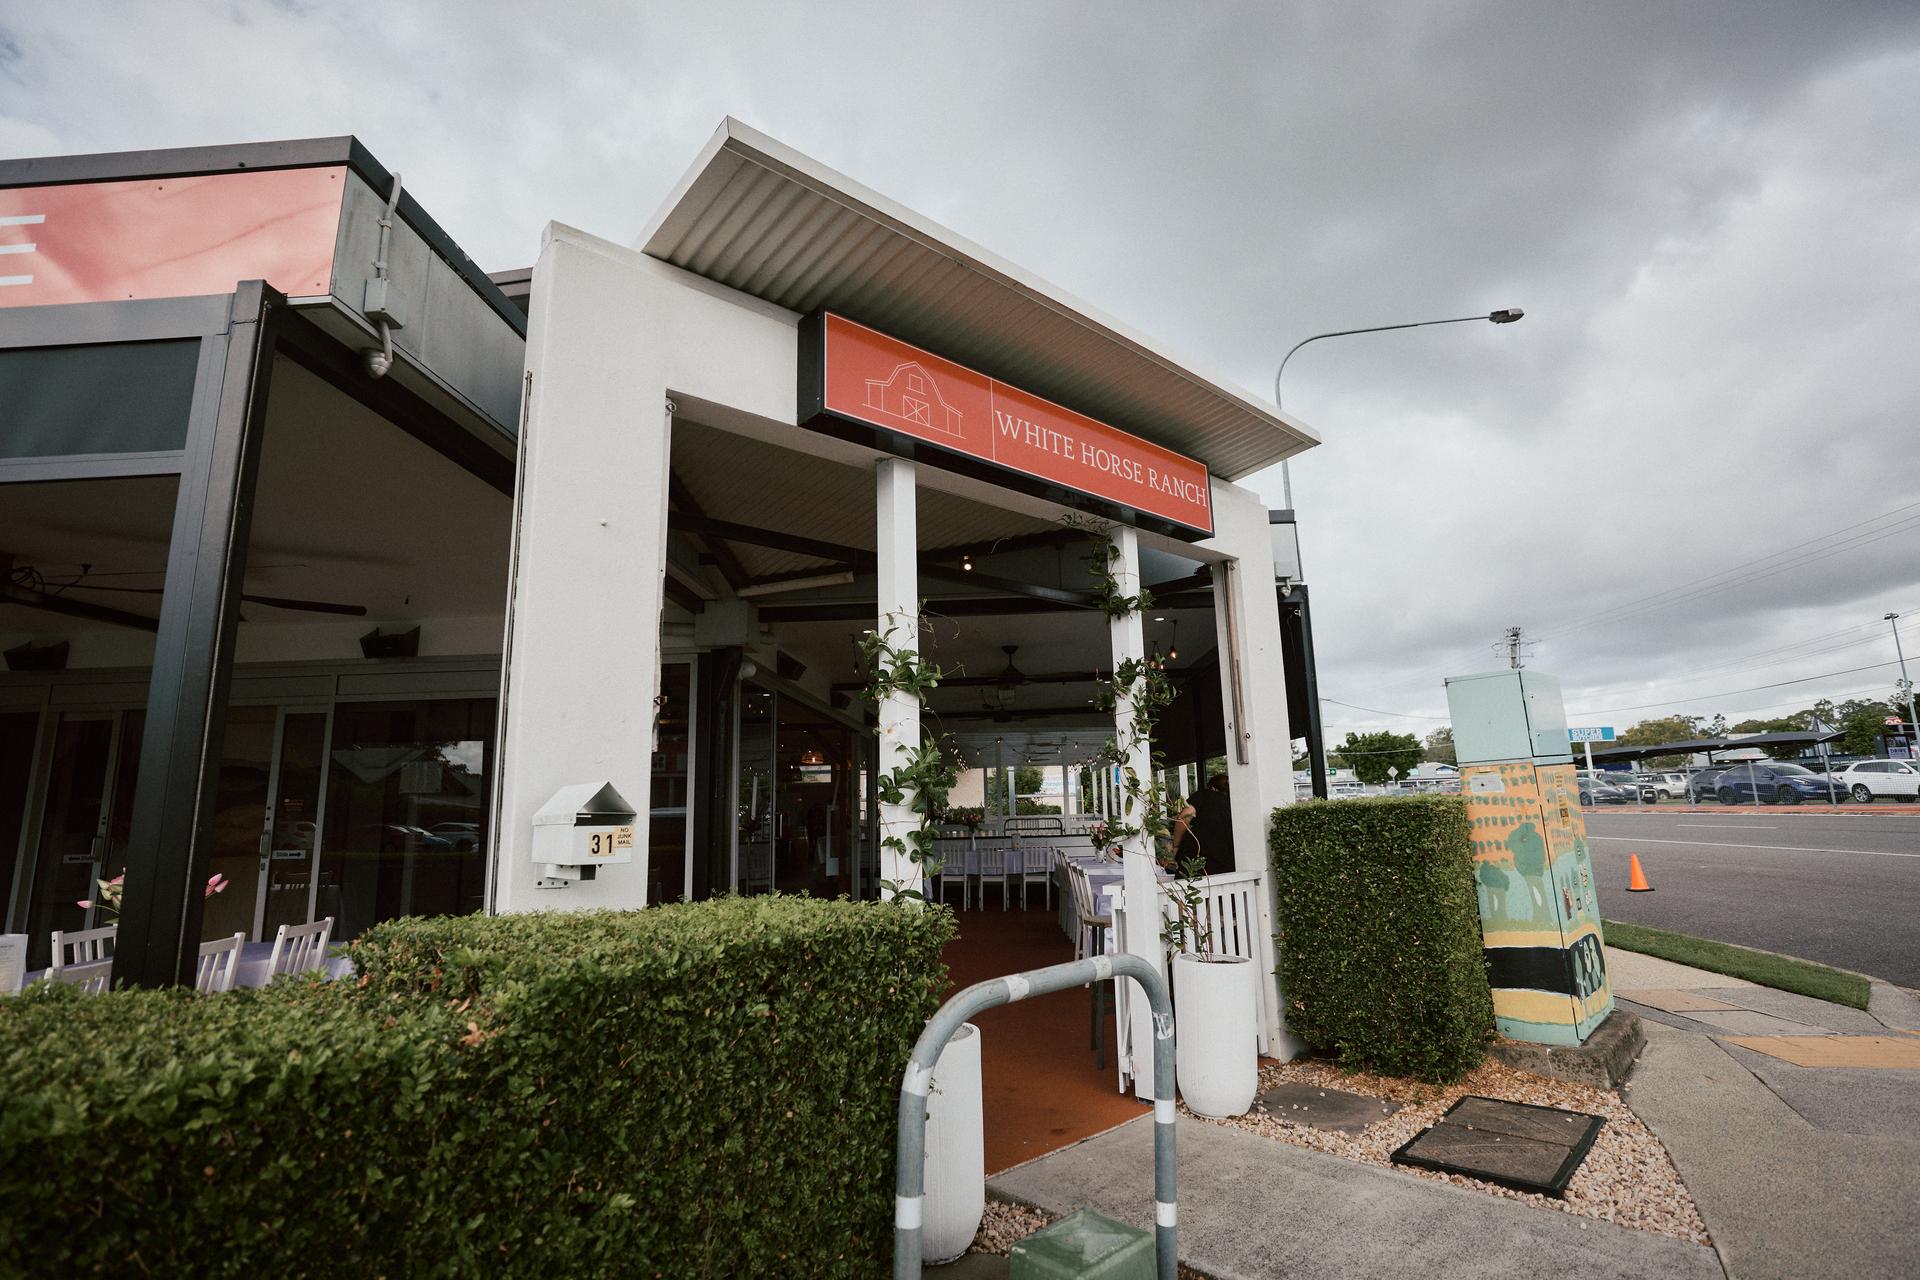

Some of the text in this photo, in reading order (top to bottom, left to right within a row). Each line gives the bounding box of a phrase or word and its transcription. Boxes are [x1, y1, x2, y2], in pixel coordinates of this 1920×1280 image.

[995, 411, 1207, 507] WHITE HORSE RANCH
[1572, 728, 1601, 736] SUPER
[592, 834, 612, 854] 31
